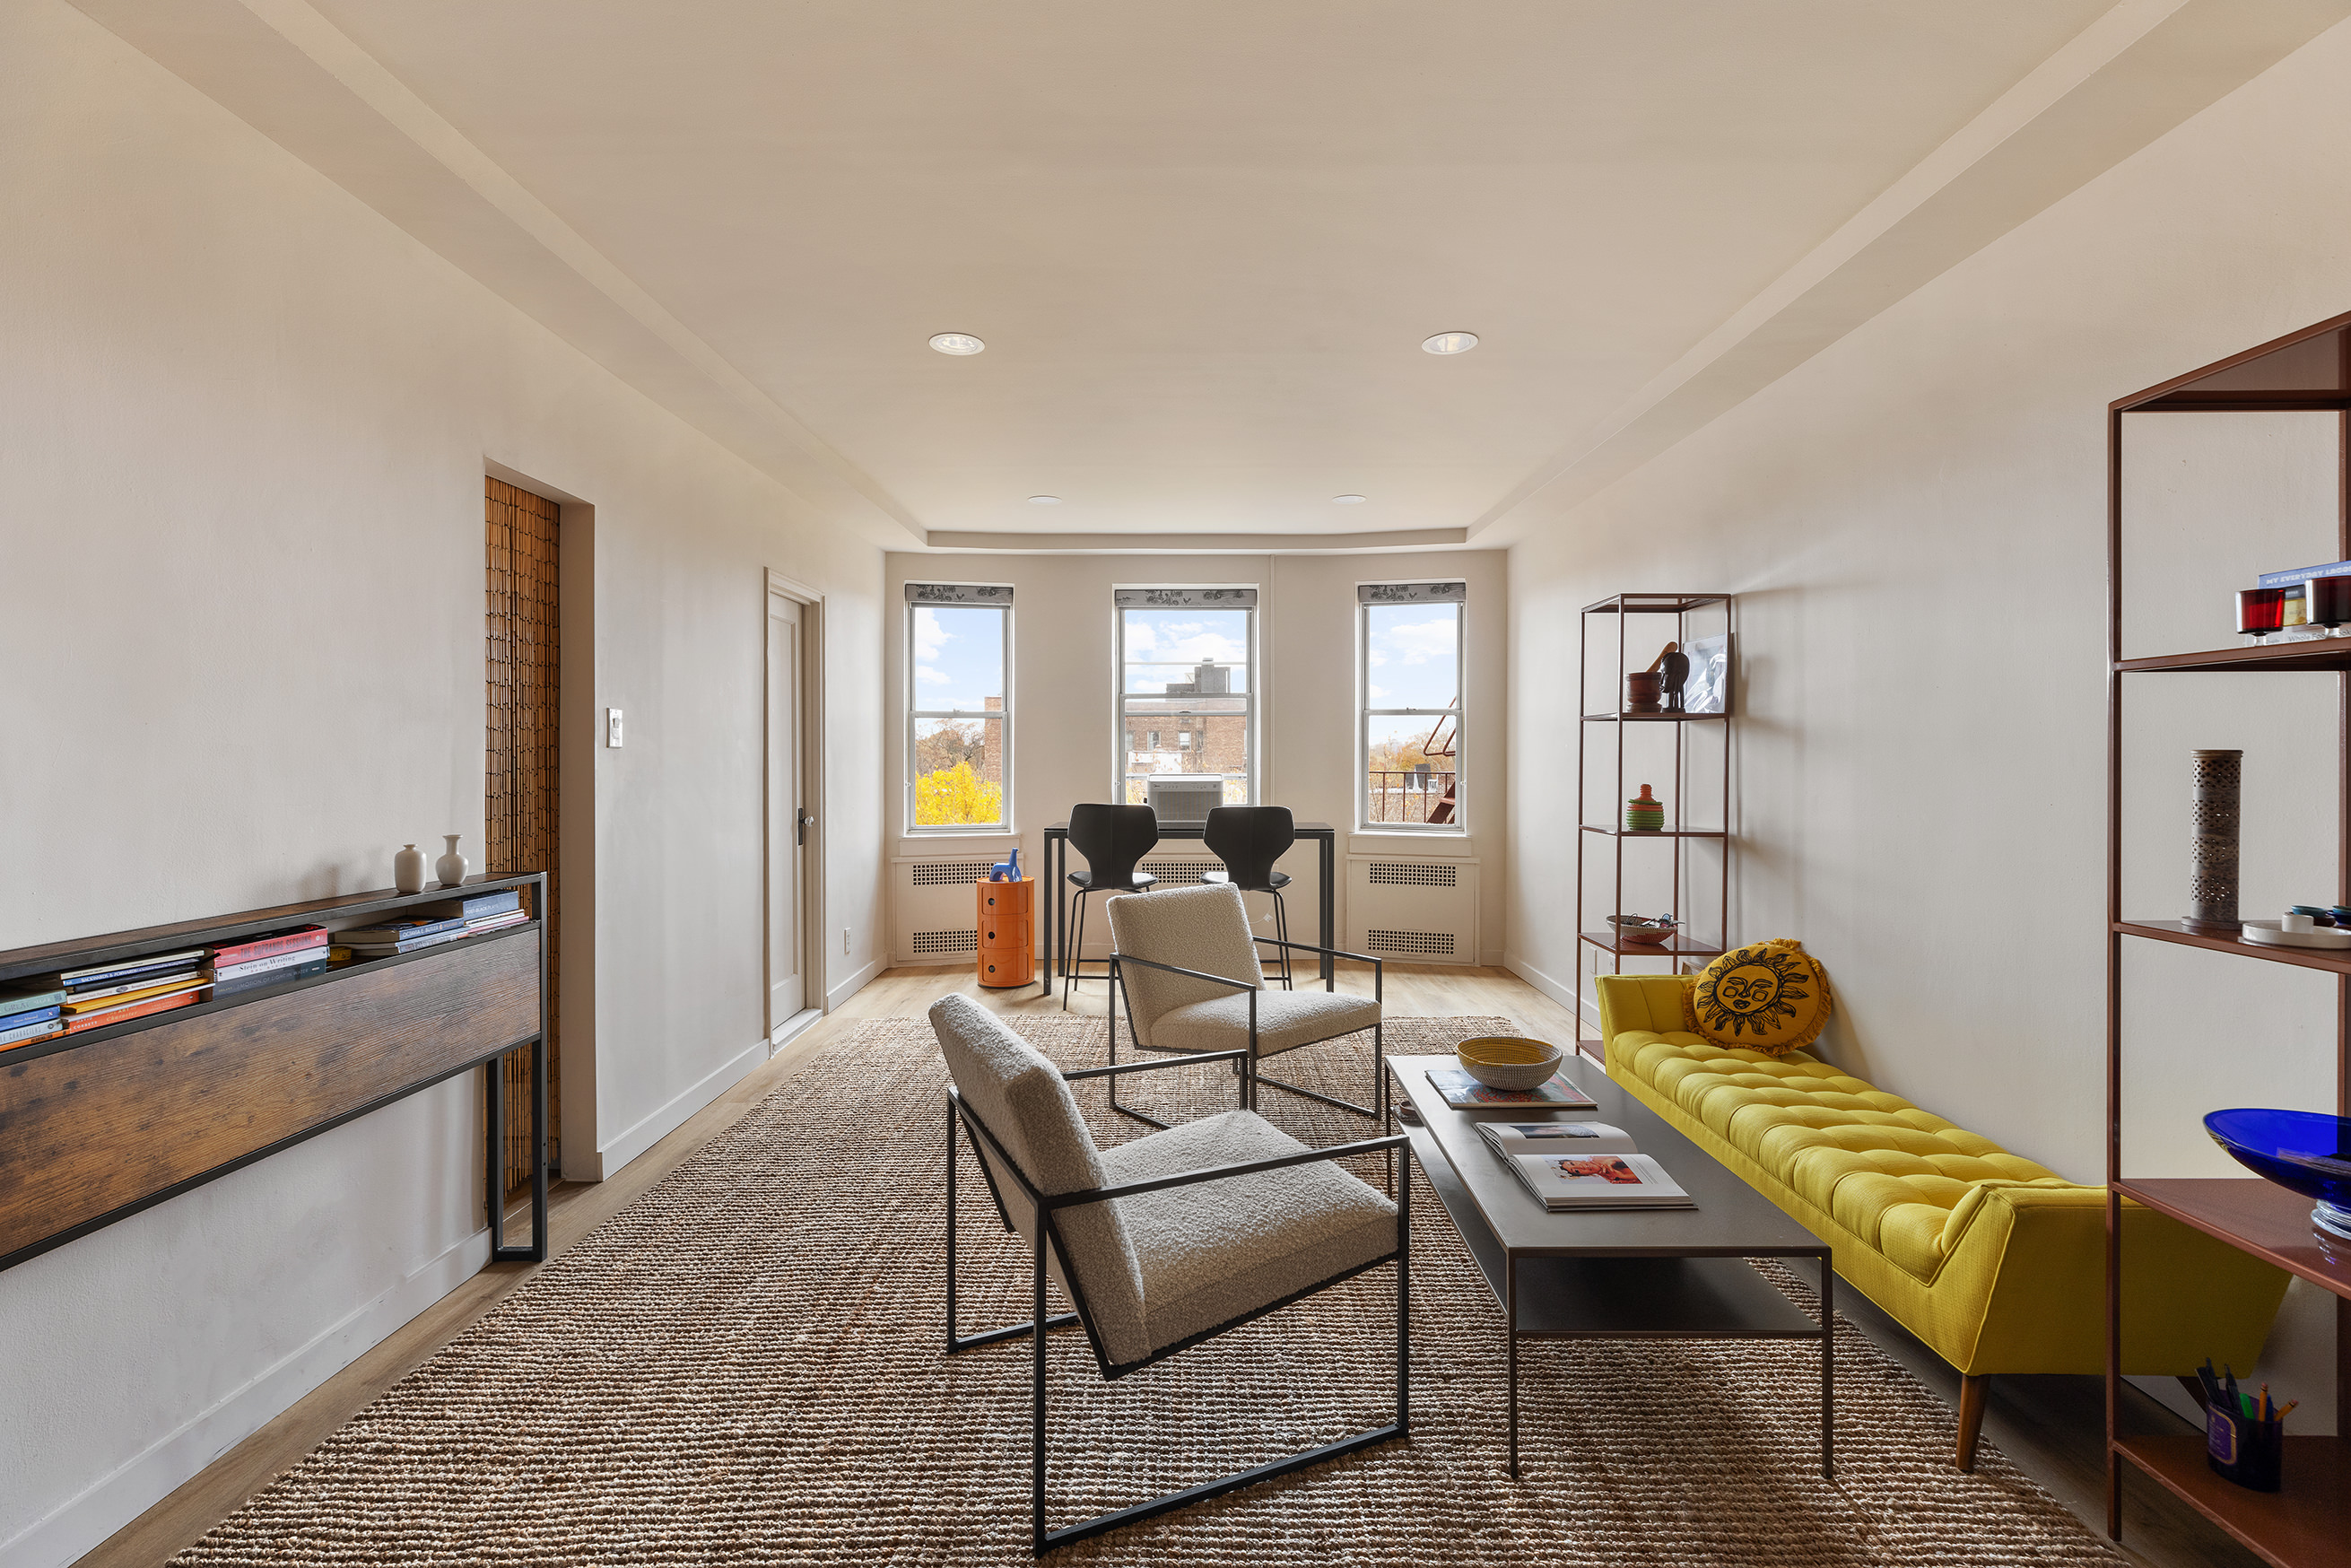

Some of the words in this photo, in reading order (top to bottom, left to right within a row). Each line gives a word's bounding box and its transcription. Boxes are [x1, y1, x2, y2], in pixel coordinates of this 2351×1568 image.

[240, 947, 251, 959] THE
[253, 939, 284, 955] SOPRANOS
[286, 935, 311, 949] SESSIONS
[239, 963, 257, 971] Stein
[270, 956, 296, 965] Writing
[73, 1021, 98, 1030] CORBETT
